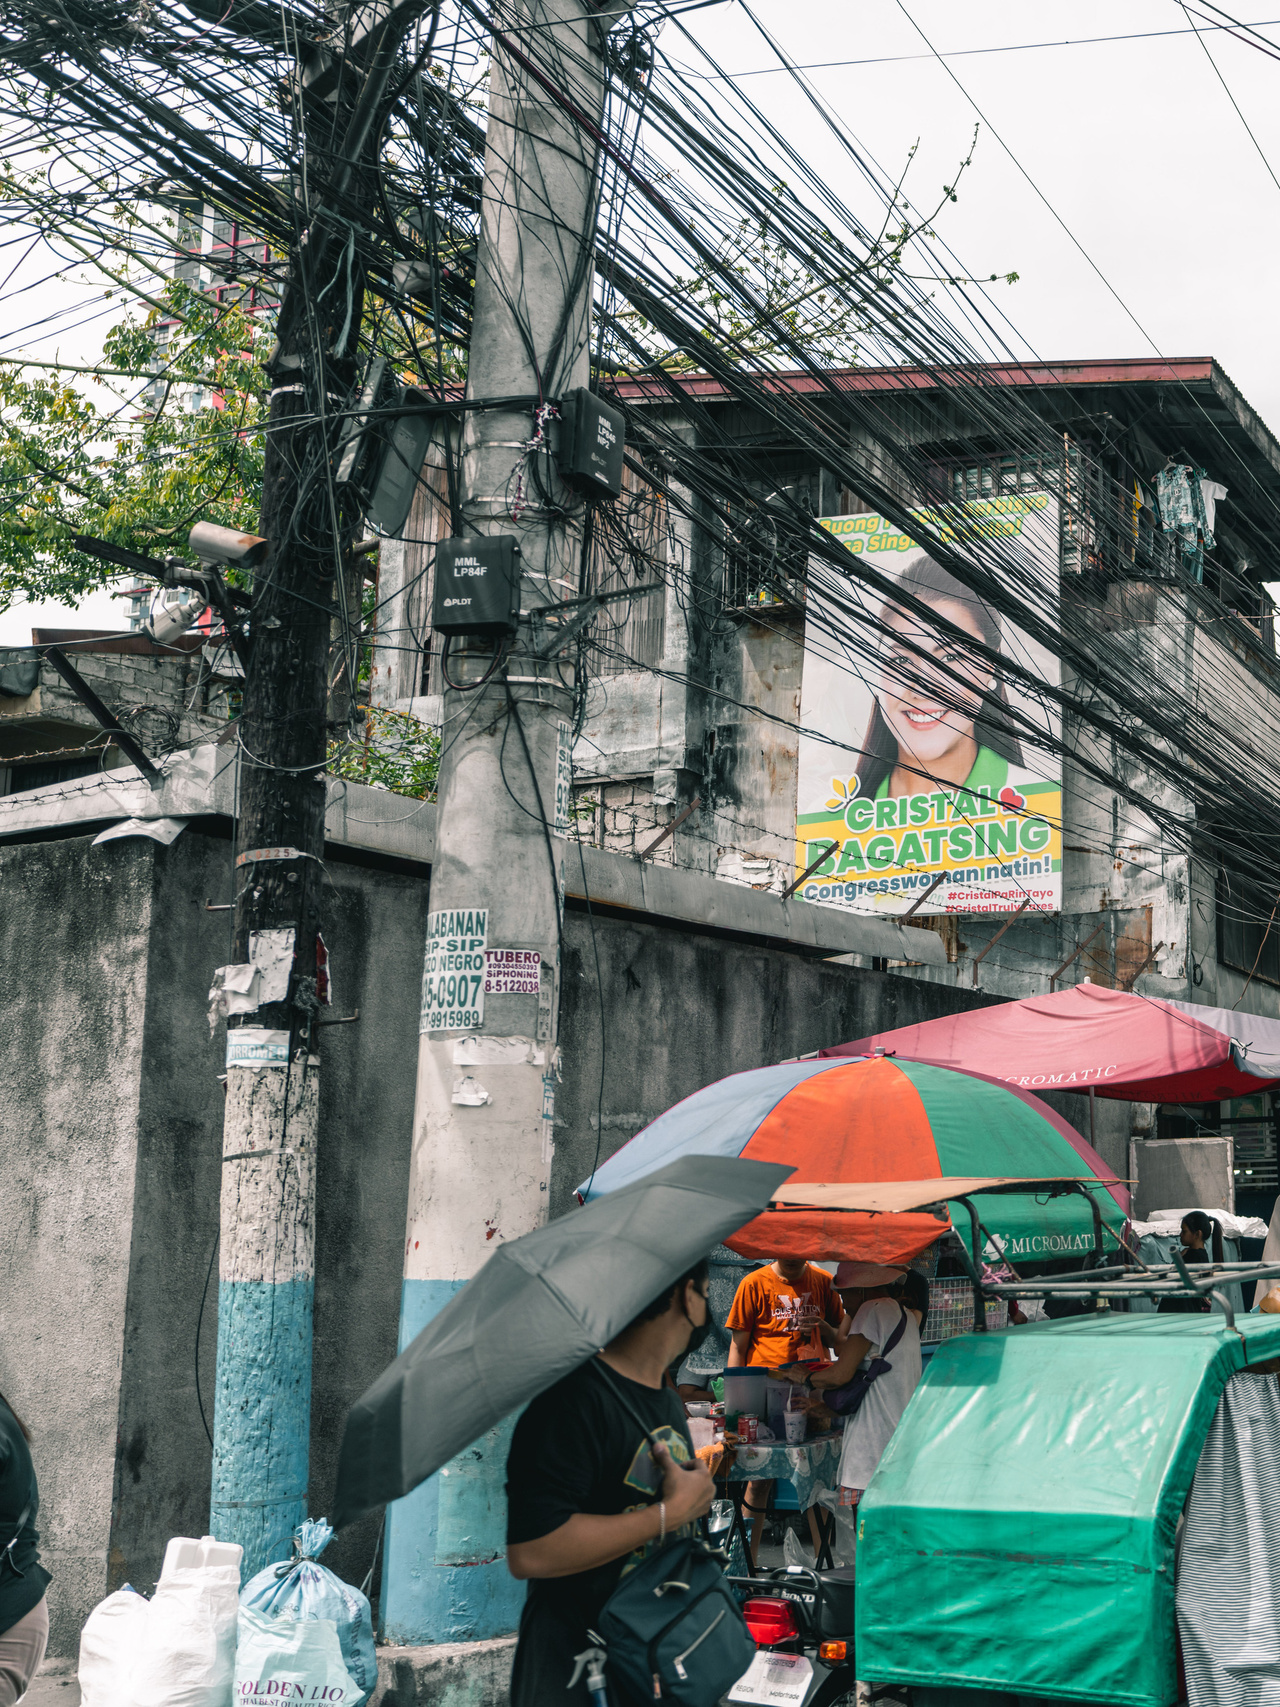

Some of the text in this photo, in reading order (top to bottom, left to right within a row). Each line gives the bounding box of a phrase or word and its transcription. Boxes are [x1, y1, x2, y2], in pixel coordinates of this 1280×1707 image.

[454, 557, 480, 567] MML
[453, 566, 488, 577] LP84F
[452, 598, 472, 606] PLDT
[845, 785, 998, 834] CRISTAL
[806, 815, 1051, 880] BAGATSING
[803, 855, 1051, 901] Congresswoman natin!
[440, 954, 484, 971] NEGRO
[484, 951, 541, 964] TUBERO
[771, 1306, 791, 1317] LOUIS
[310, 1685, 347, 1703] LIO
[735, 1684, 754, 1693] REGION
